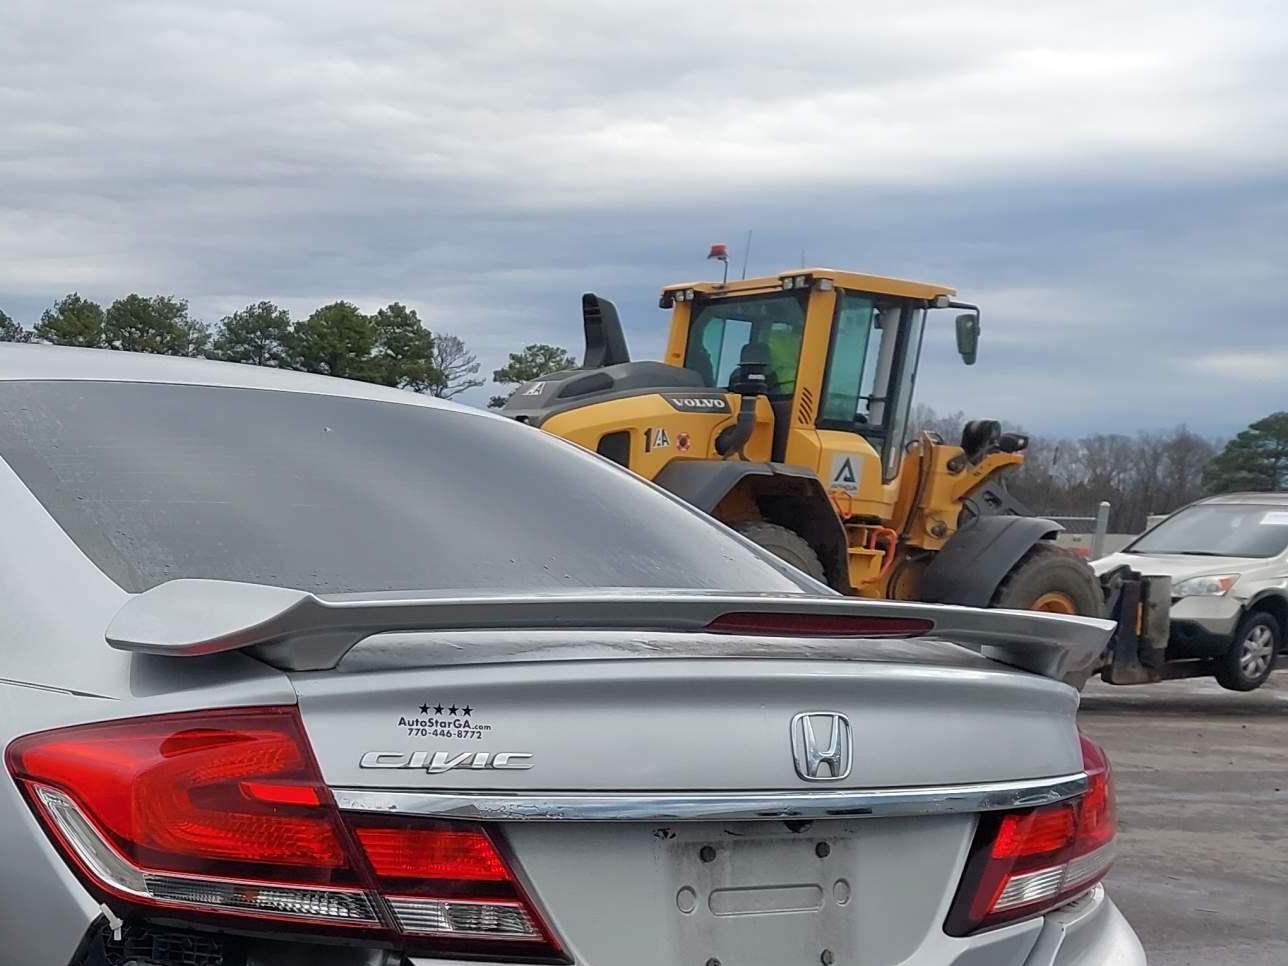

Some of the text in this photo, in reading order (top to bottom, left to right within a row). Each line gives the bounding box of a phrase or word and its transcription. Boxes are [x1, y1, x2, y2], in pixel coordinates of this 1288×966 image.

[672, 398, 725, 408] VOLVO
[398, 717, 492, 730] AutoStarGA.com
[407, 728, 483, 739] 770-446-8772
